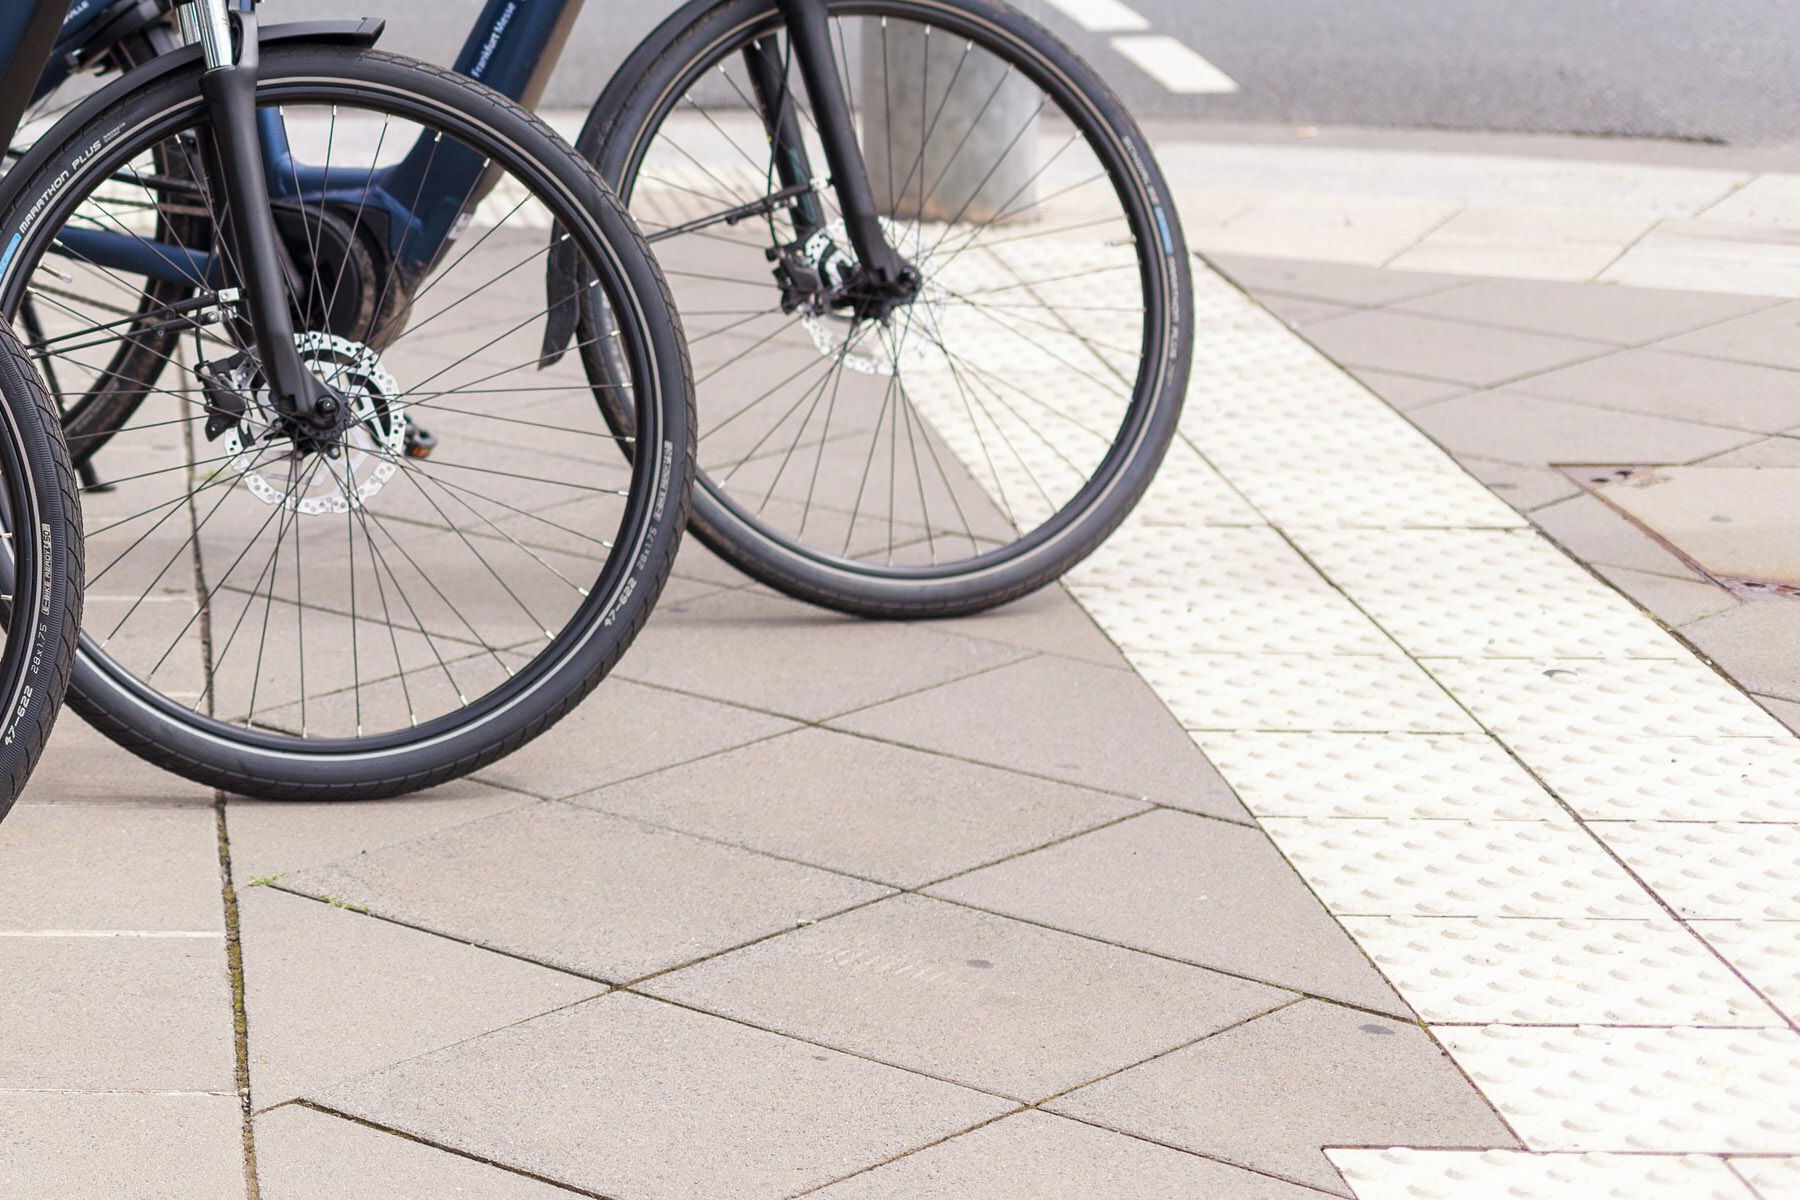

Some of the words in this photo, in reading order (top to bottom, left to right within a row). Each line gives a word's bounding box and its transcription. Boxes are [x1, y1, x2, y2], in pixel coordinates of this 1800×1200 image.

[18, 170, 70, 234] MARATHON
[71, 140, 102, 171] PLUS
[4, 685, 33, 746] 47-622
[31, 624, 47, 674] 28x1.75
